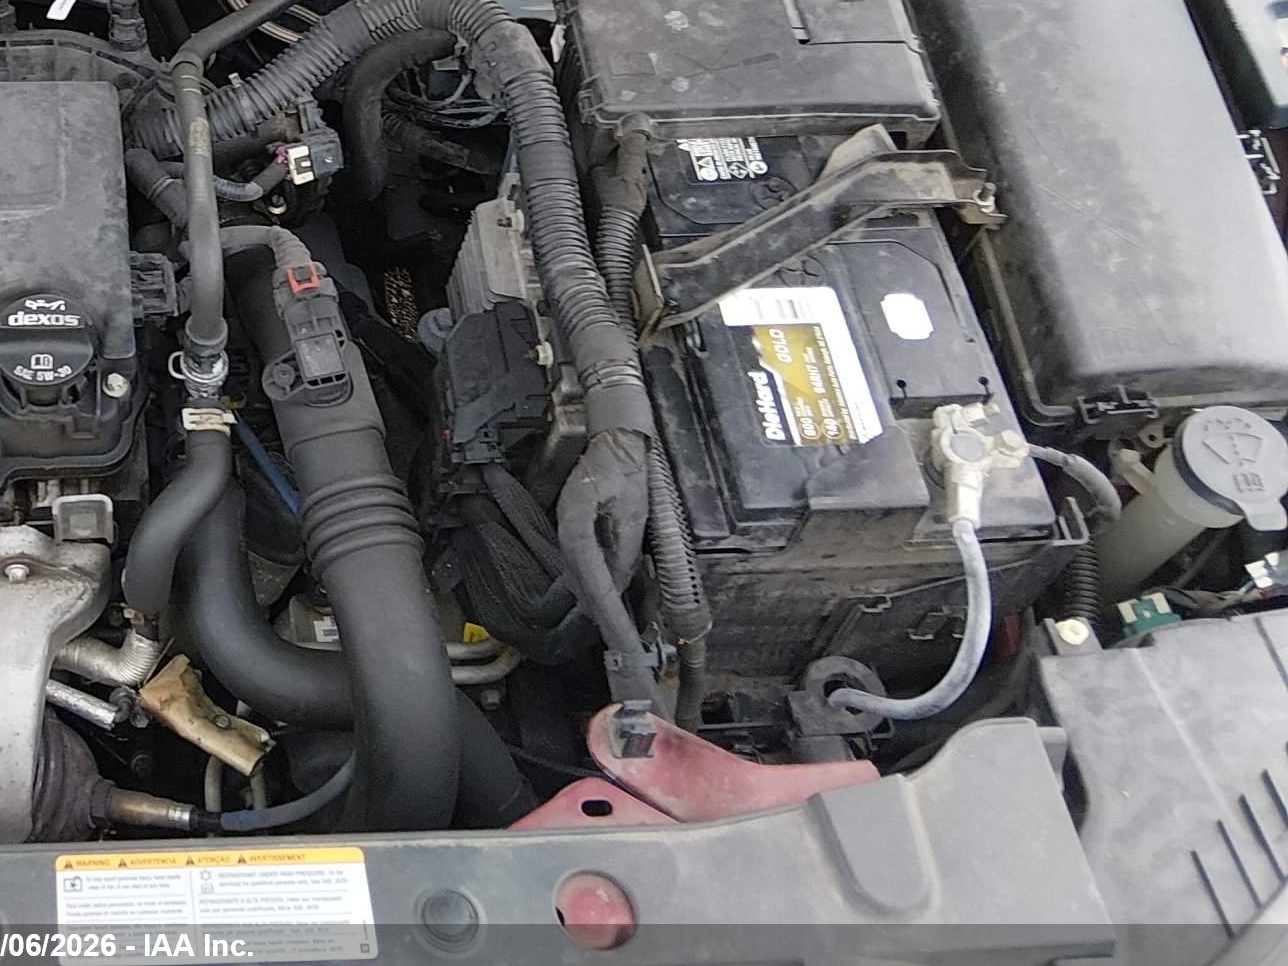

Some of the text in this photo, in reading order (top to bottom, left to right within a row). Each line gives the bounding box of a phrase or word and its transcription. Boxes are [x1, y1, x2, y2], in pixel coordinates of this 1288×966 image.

[8, 311, 81, 326] dexos
[769, 328, 792, 363] GOLD
[747, 370, 787, 441] DieHard
[75, 858, 111, 867] WARNING
